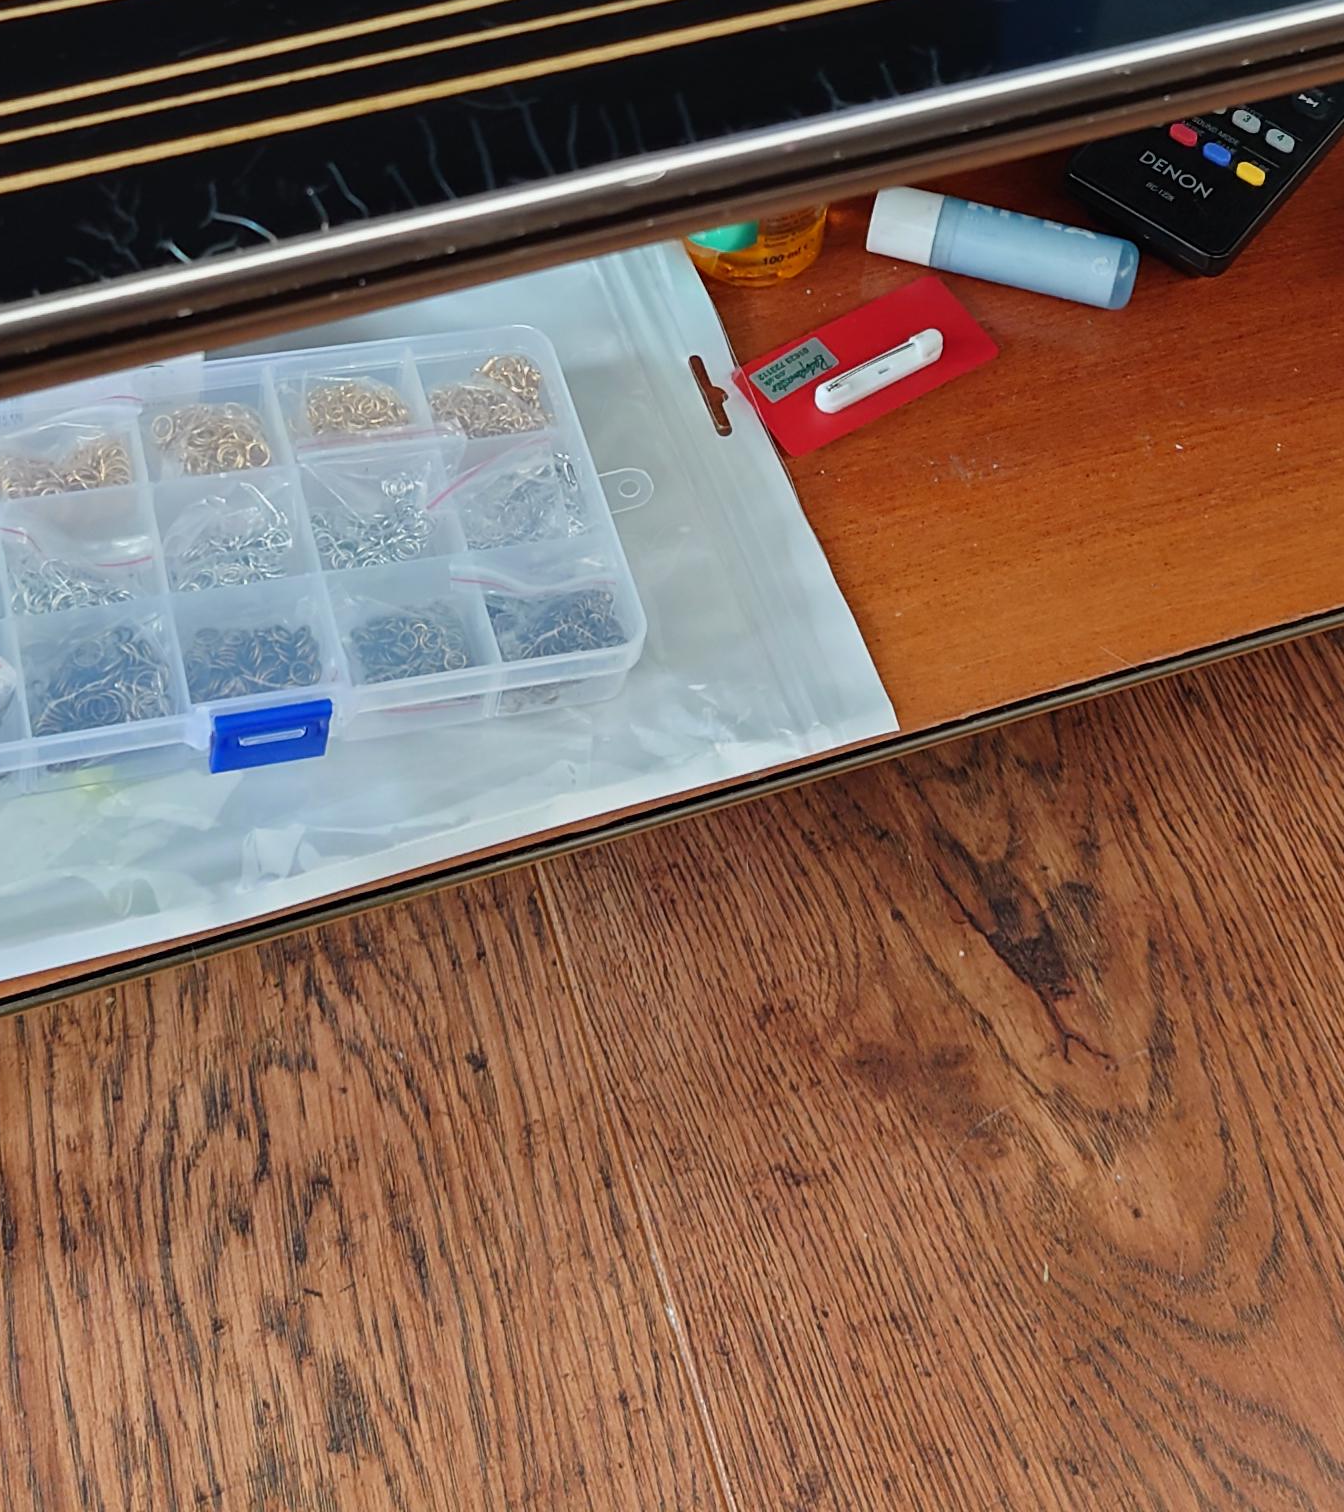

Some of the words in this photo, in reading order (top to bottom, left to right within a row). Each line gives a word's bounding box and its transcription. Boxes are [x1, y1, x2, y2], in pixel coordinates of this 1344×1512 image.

[1243, 114, 1252, 123] 3
[1218, 129, 1240, 146] MODE
[1277, 134, 1285, 142] 4
[1139, 150, 1214, 199] DENON
[763, 254, 785, 265] 100
